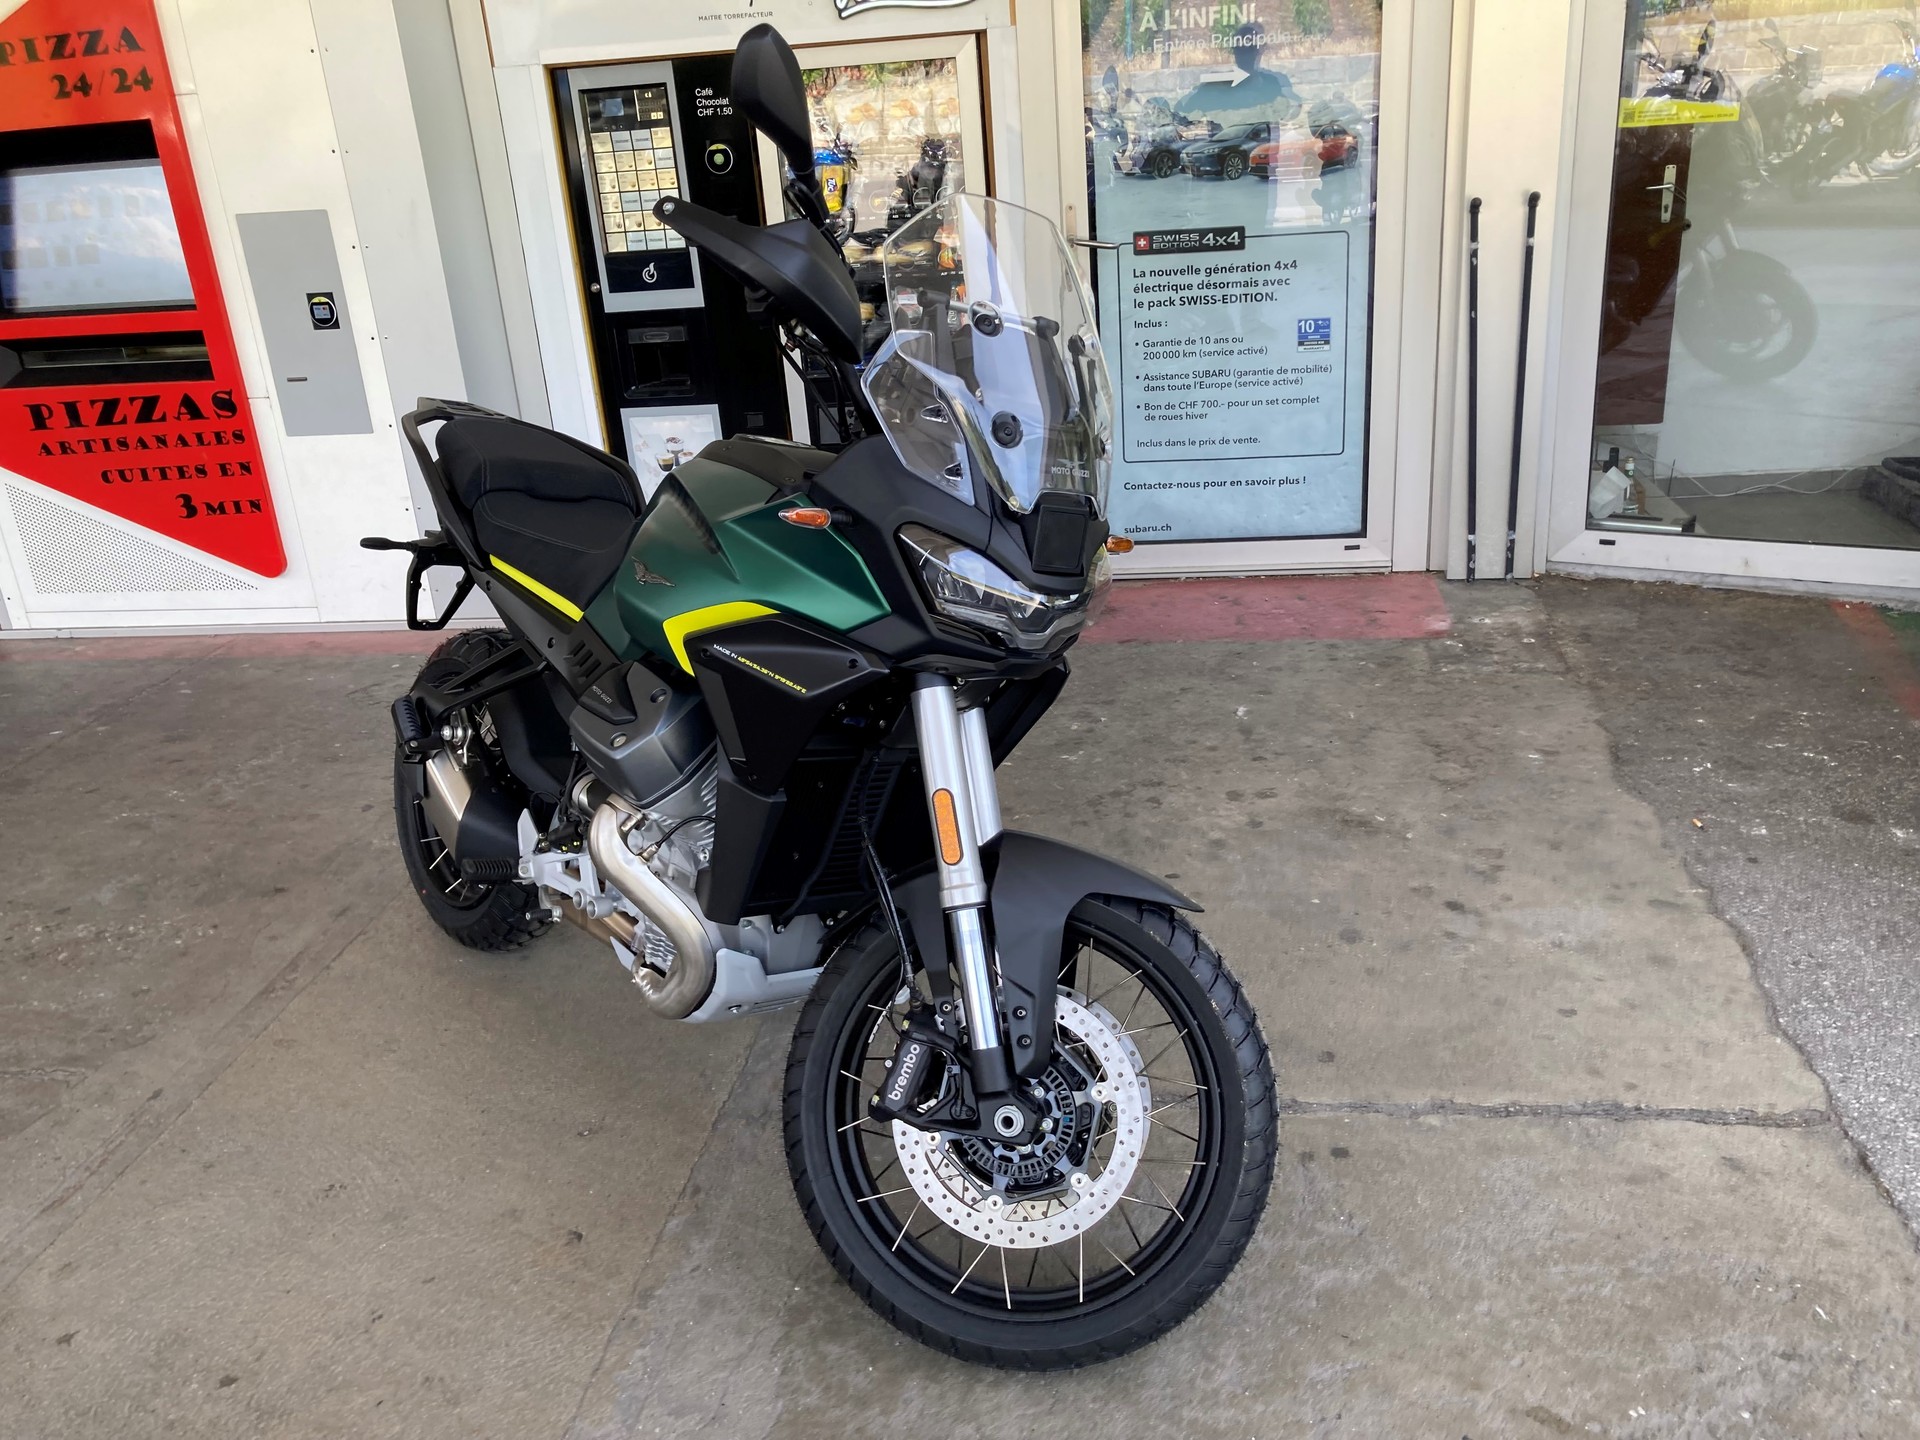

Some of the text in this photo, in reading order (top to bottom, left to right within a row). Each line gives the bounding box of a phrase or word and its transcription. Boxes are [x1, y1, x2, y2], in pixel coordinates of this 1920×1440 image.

[724, 11, 774, 20] TORREFACTEUR
[1139, 6, 1158, 32] À
[0, 26, 145, 66] PIZZA
[1153, 37, 1206, 53] Entrée
[1211, 30, 1291, 49] Principale
[695, 88, 713, 97] Café
[696, 97, 729, 107] Chocolat
[697, 107, 733, 117] CHF 1.50
[1153, 231, 1241, 246] SWISS 4x4
[1153, 241, 1199, 249] EDITION
[1133, 260, 1298, 278] La nouvelle génération 4x4
[1133, 277, 1291, 294] électrique désormais avec
[1134, 291, 1278, 311] le pack SWISS-EDITION.
[1134, 320, 1162, 329] Inclus
[1298, 320, 1315, 333] 10
[1143, 338, 1182, 348] Garantie
[1184, 337, 1196, 346] de
[1199, 336, 1211, 345] 10
[1182, 349, 1197, 358] km
[1199, 347, 1234, 358] (service
[1237, 346, 1268, 356] activé)
[1143, 364, 1332, 381] Assistance SUBARU (garantie de mobilité)
[1143, 376, 1304, 392] dans toute l'Europe (service activé)
[24, 389, 239, 431] PIZZAS
[1144, 395, 1320, 411] Bon de CHF 700.- pour un set complet
[1144, 411, 1208, 421] de roues hiver
[37, 429, 246, 457] ARTISANALES
[1137, 436, 1261, 448] Inclus dans le prix de vente.
[101, 461, 253, 484] CUITES EN
[1051, 466, 1070, 475] MOTO
[1123, 480, 1201, 491] Contactez-nous
[1203, 479, 1228, 490] pour
[1229, 479, 1242, 487] en
[1245, 476, 1276, 486] savoir
[1278, 476, 1300, 487] plus
[175, 493, 262, 519] 3 MIN
[1124, 523, 1172, 534] subaru.ch
[713, 643, 731, 656] MADE
[888, 1044, 920, 1100] brembo
